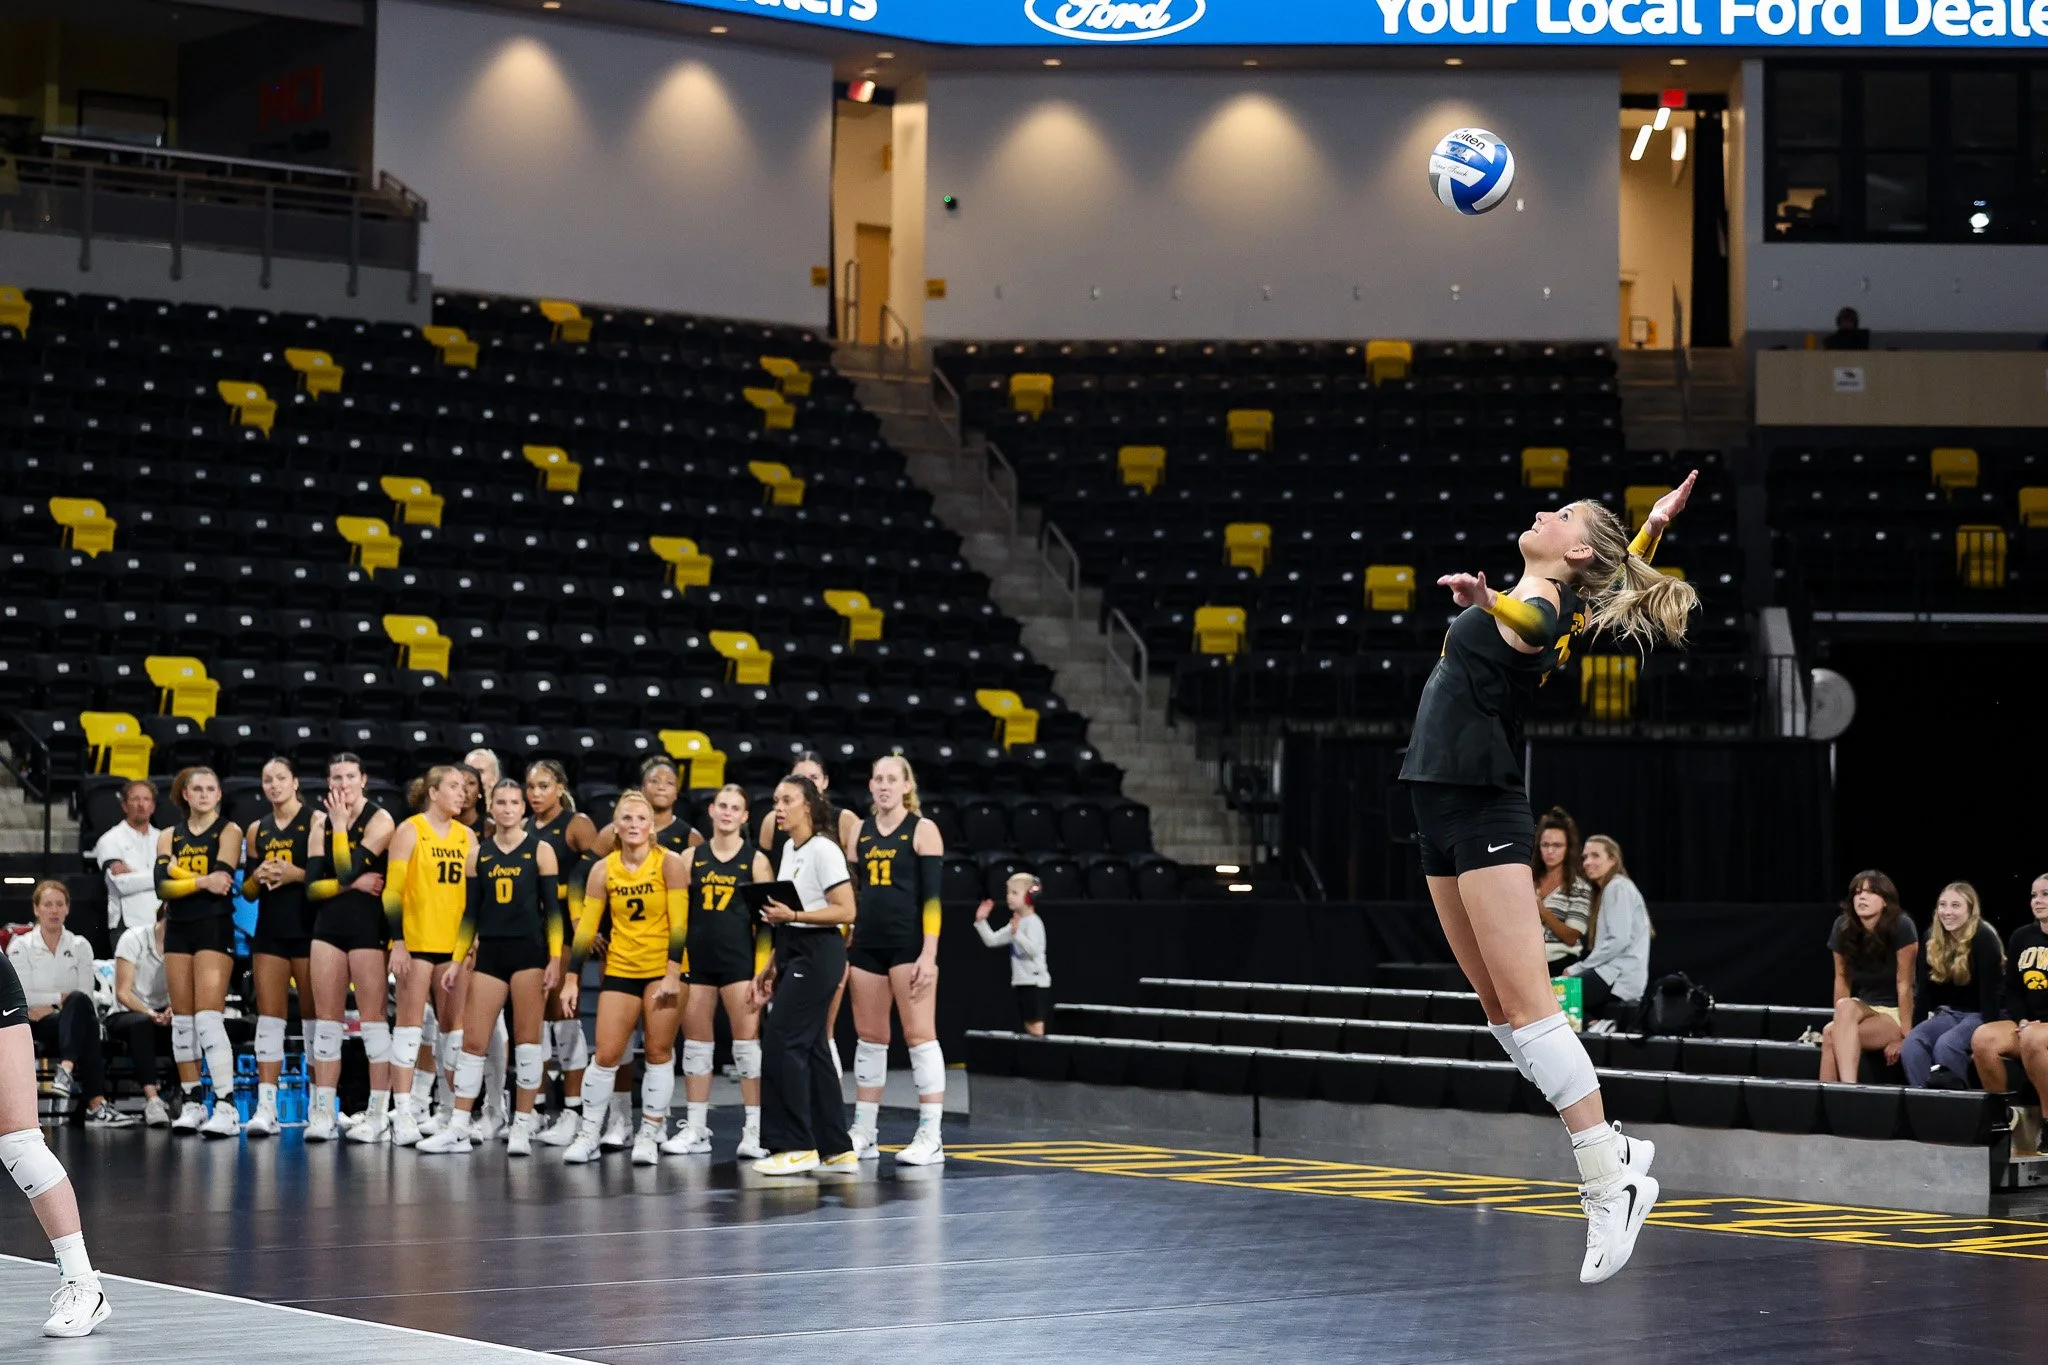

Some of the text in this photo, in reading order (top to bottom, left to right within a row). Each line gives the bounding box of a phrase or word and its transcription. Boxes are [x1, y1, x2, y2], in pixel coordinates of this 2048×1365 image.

[1055, 0, 1171, 30] Ford
[1374, 0, 1518, 35] Your
[1536, 0, 1702, 35] Local
[1720, 0, 1862, 36] Ford
[437, 861, 463, 885] 16
[867, 859, 892, 886] 11
[495, 877, 514, 905] 0
[701, 884, 736, 912] 17
[626, 898, 646, 922] 2
